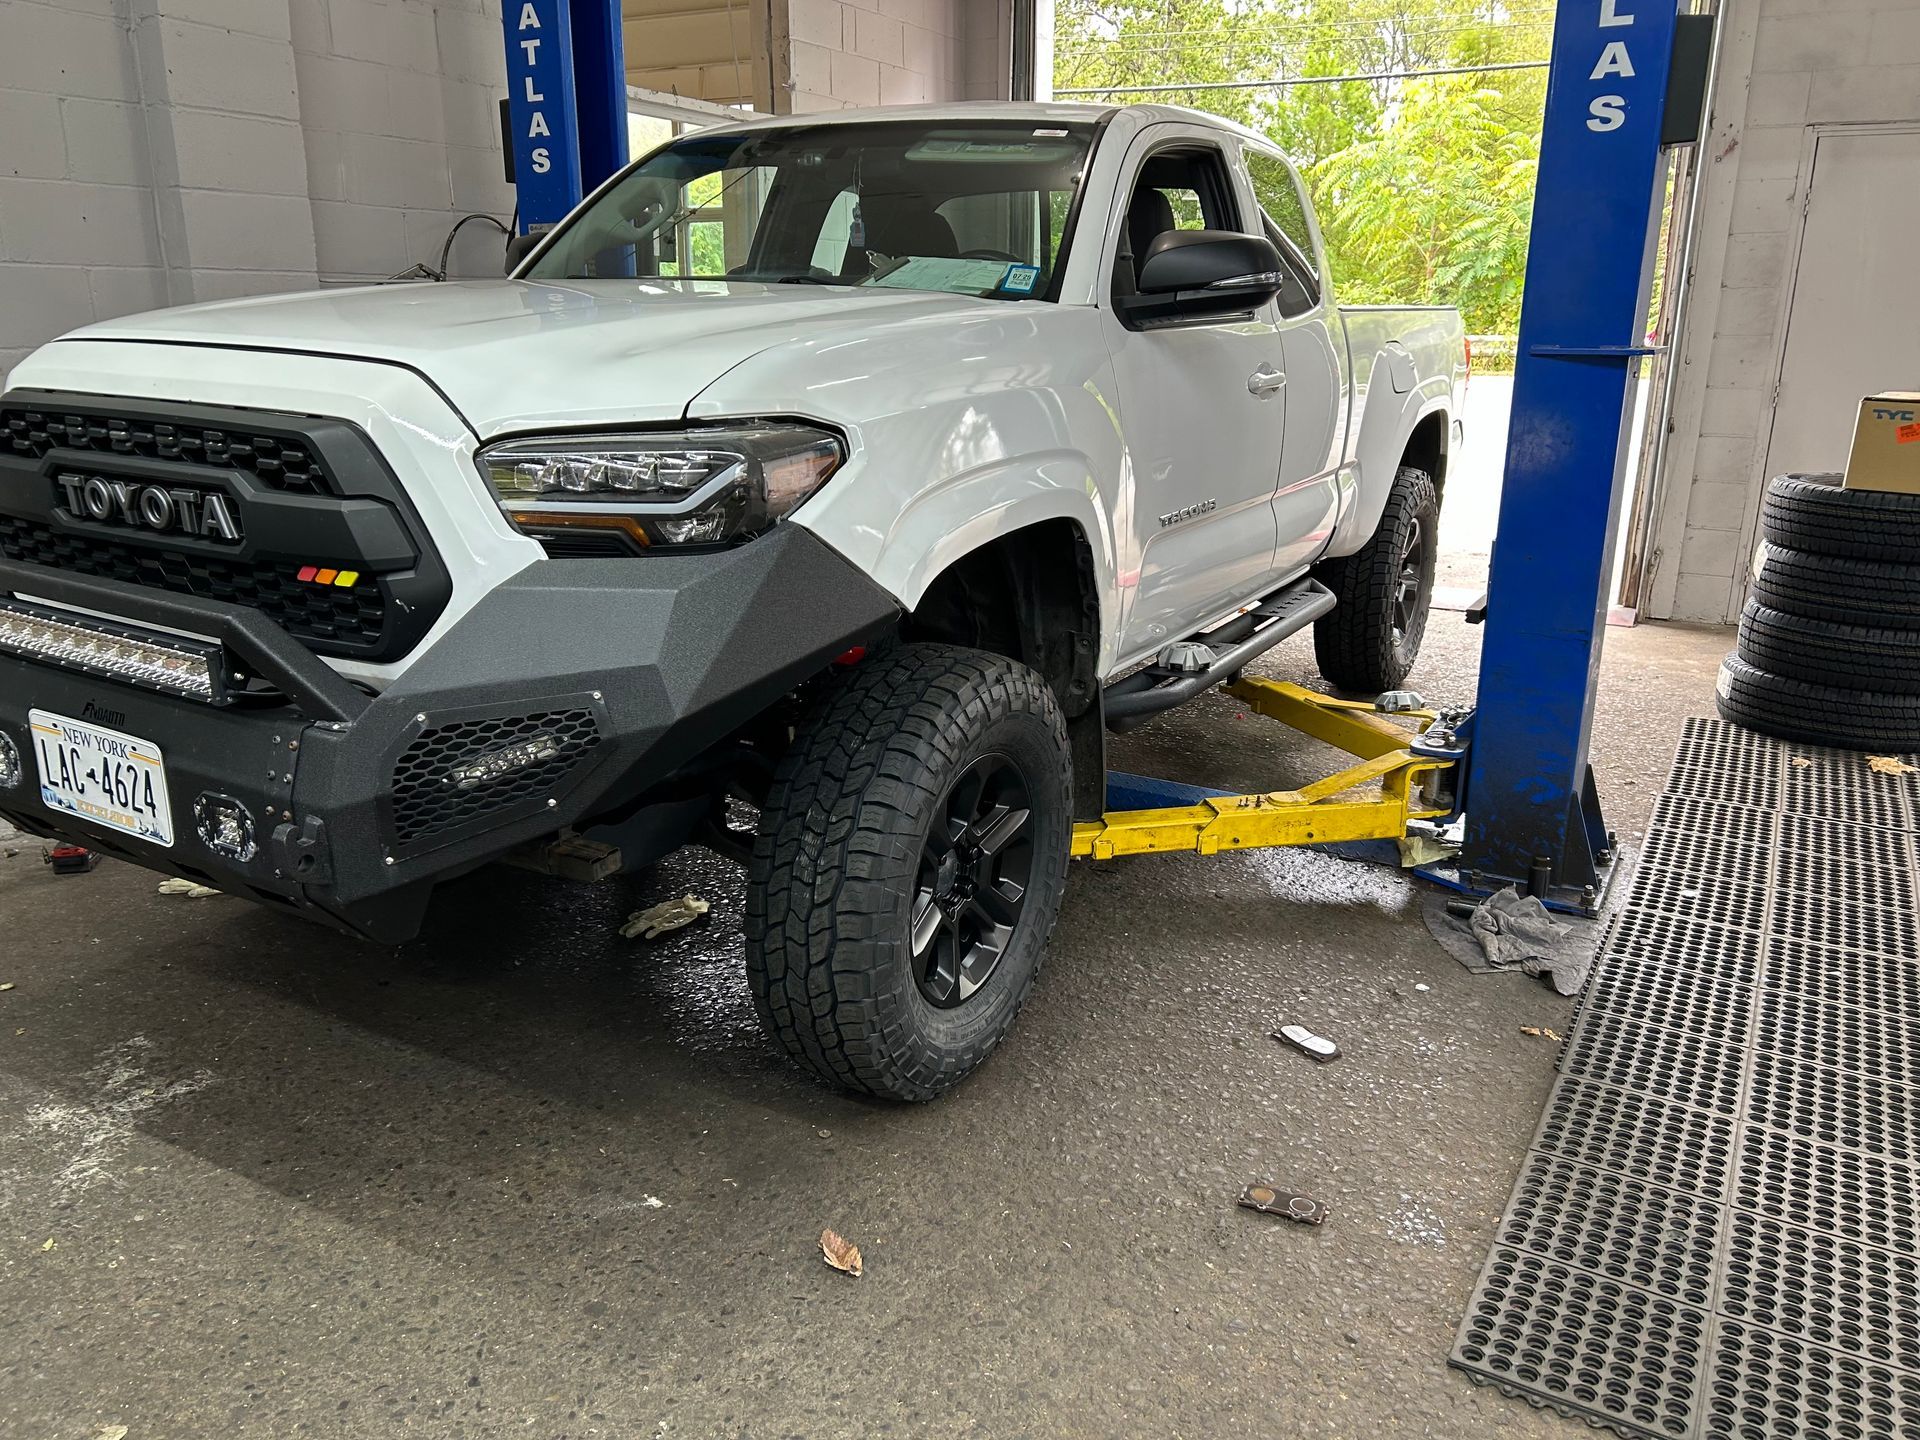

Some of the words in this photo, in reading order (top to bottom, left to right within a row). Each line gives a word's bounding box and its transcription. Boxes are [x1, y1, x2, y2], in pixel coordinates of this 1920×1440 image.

[518, 2, 551, 174] ATLAS
[1872, 408, 1915, 421] TYC
[57, 472, 239, 540] TOYOTA
[62, 726, 92, 749] NEW
[94, 735, 130, 760] YORK
[41, 738, 85, 795] LAC
[102, 756, 157, 819] 4624
